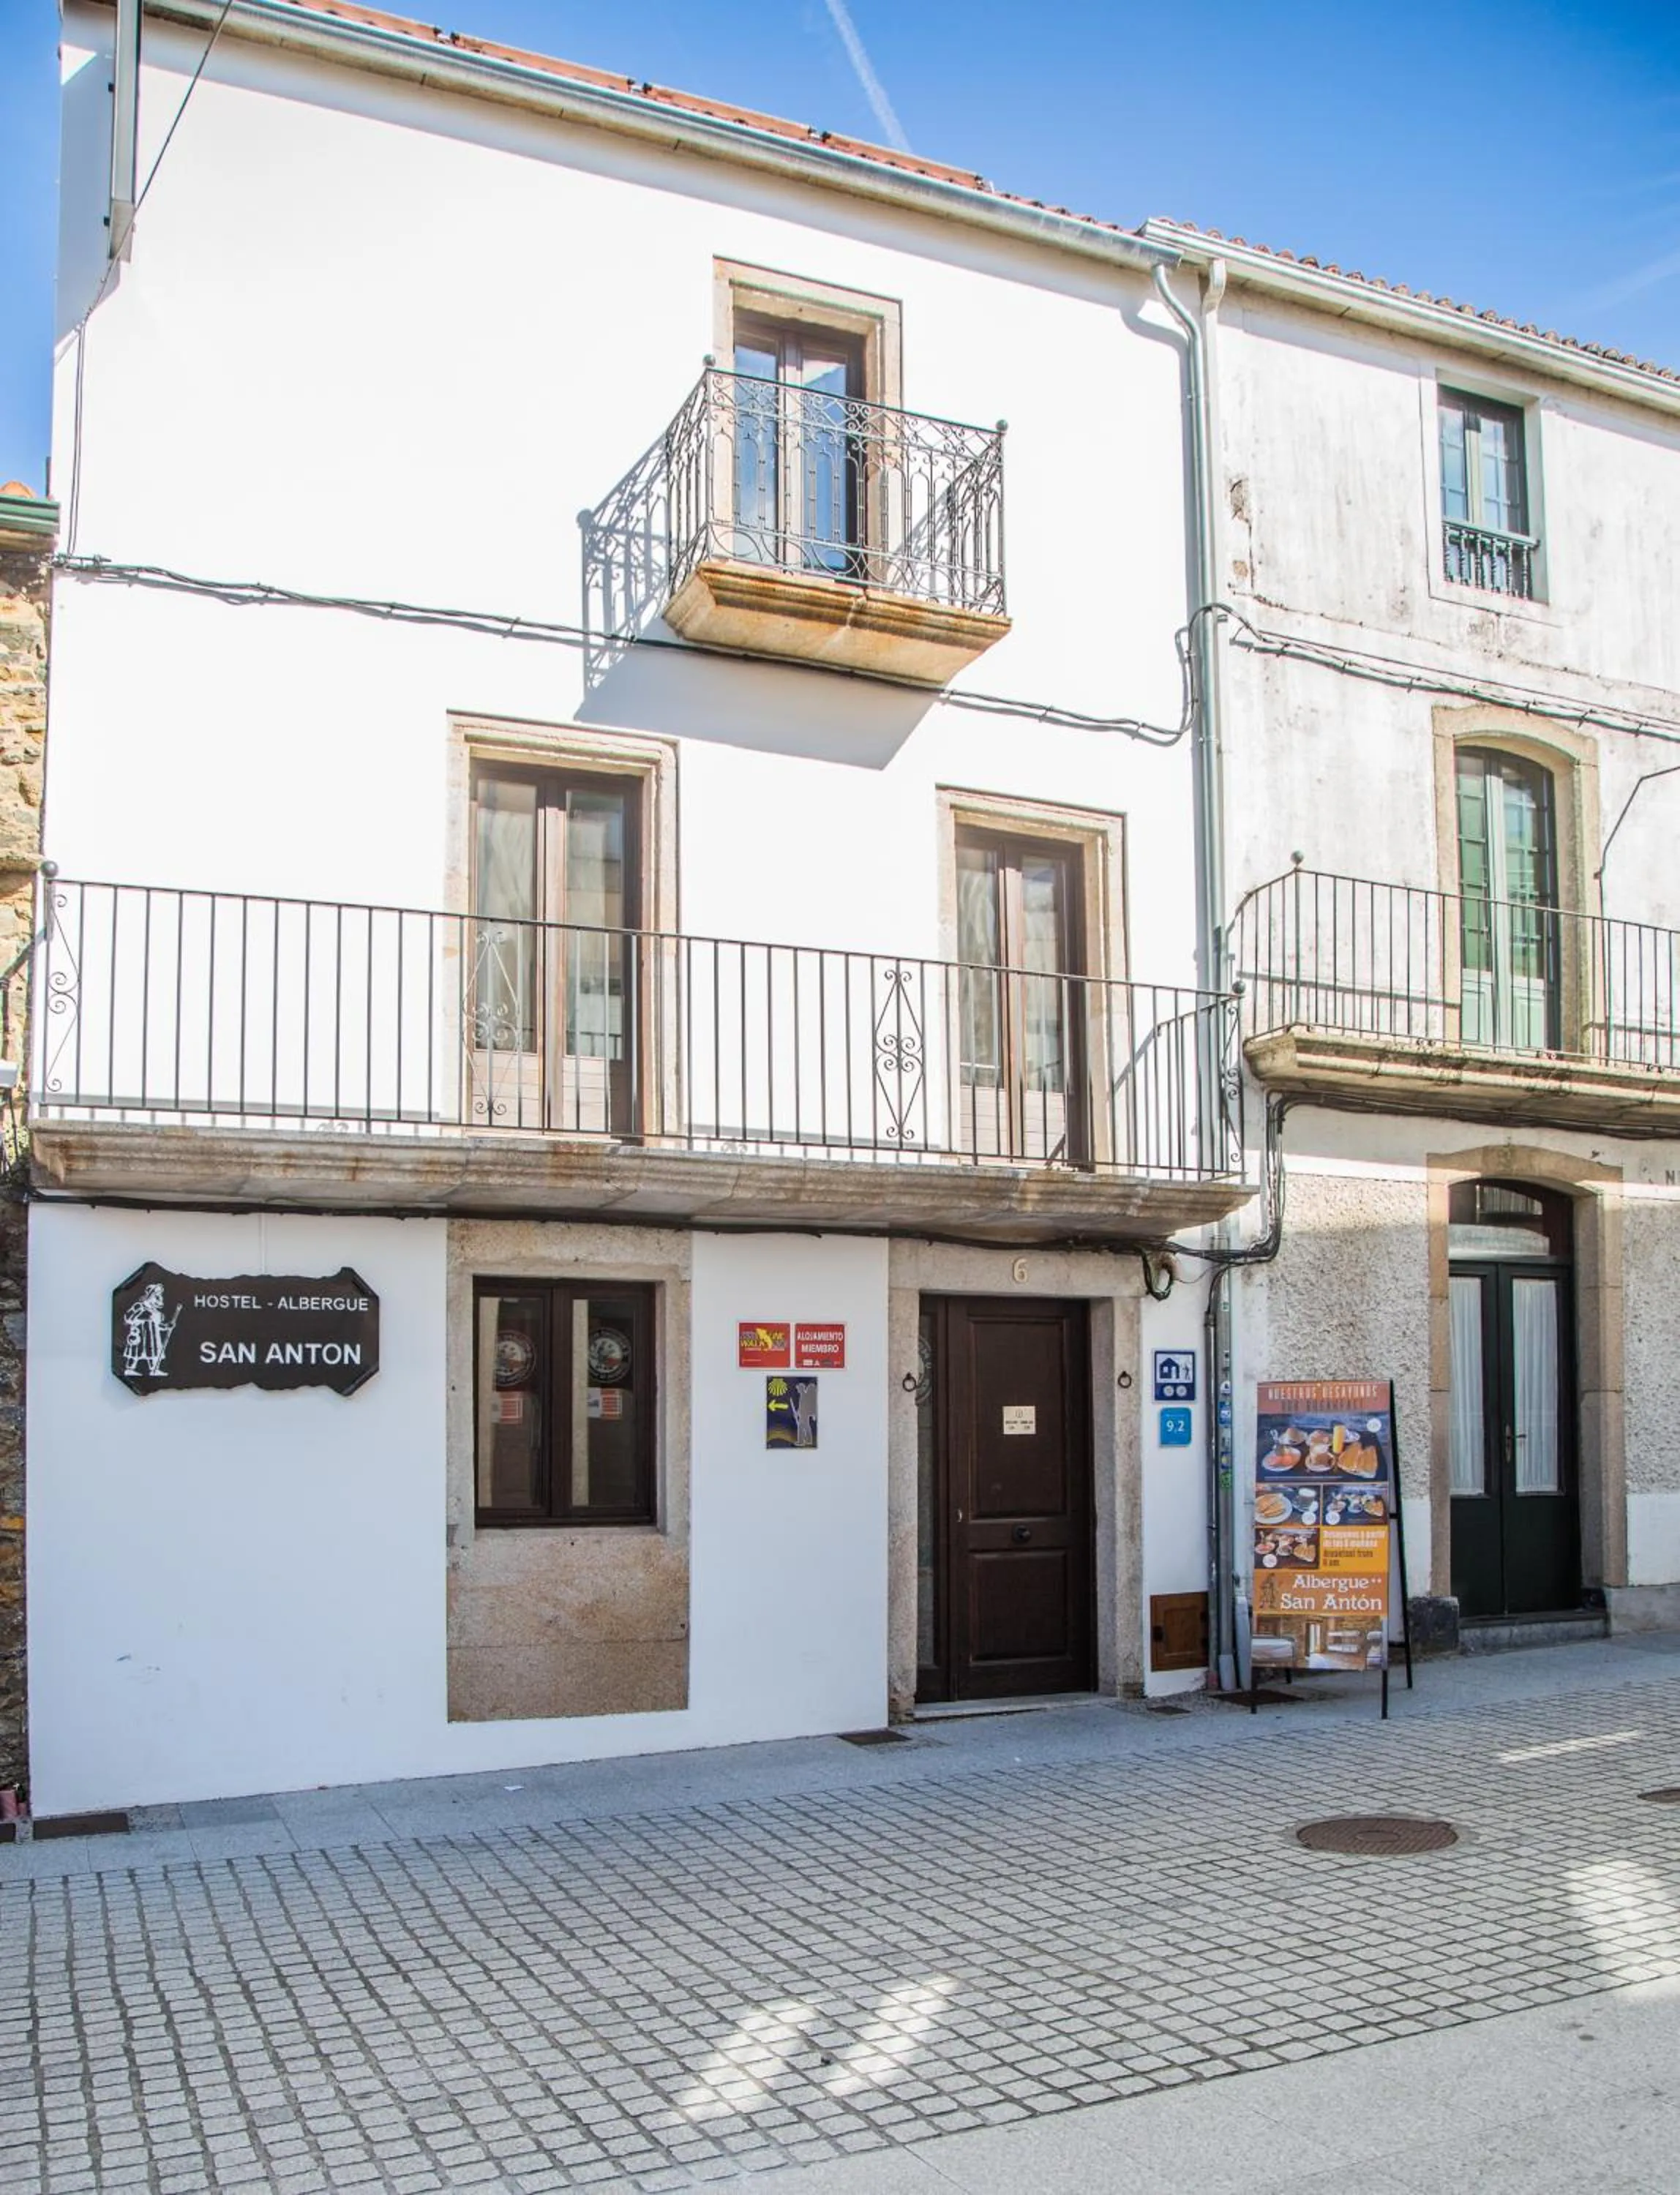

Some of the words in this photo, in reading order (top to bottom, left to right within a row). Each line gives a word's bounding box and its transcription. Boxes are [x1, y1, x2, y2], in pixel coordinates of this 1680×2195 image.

[1012, 1258, 1028, 1283] 6
[194, 1295, 261, 1310] HOSTEL
[278, 1297, 369, 1311] ALBERGUE
[797, 1332, 843, 1341] ALOJAMIENTO
[200, 1341, 256, 1364] SAN
[266, 1343, 361, 1365] ANTON
[801, 1344, 839, 1353] MIEMBRO
[1268, 1386, 1317, 1400] NUESTROS
[1322, 1384, 1379, 1399] DESAYUNOS
[1166, 1419, 1185, 1434] 9,2
[1292, 1575, 1369, 1593] Albergue
[1281, 1594, 1316, 1610] San
[1322, 1594, 1382, 1610] Antón
